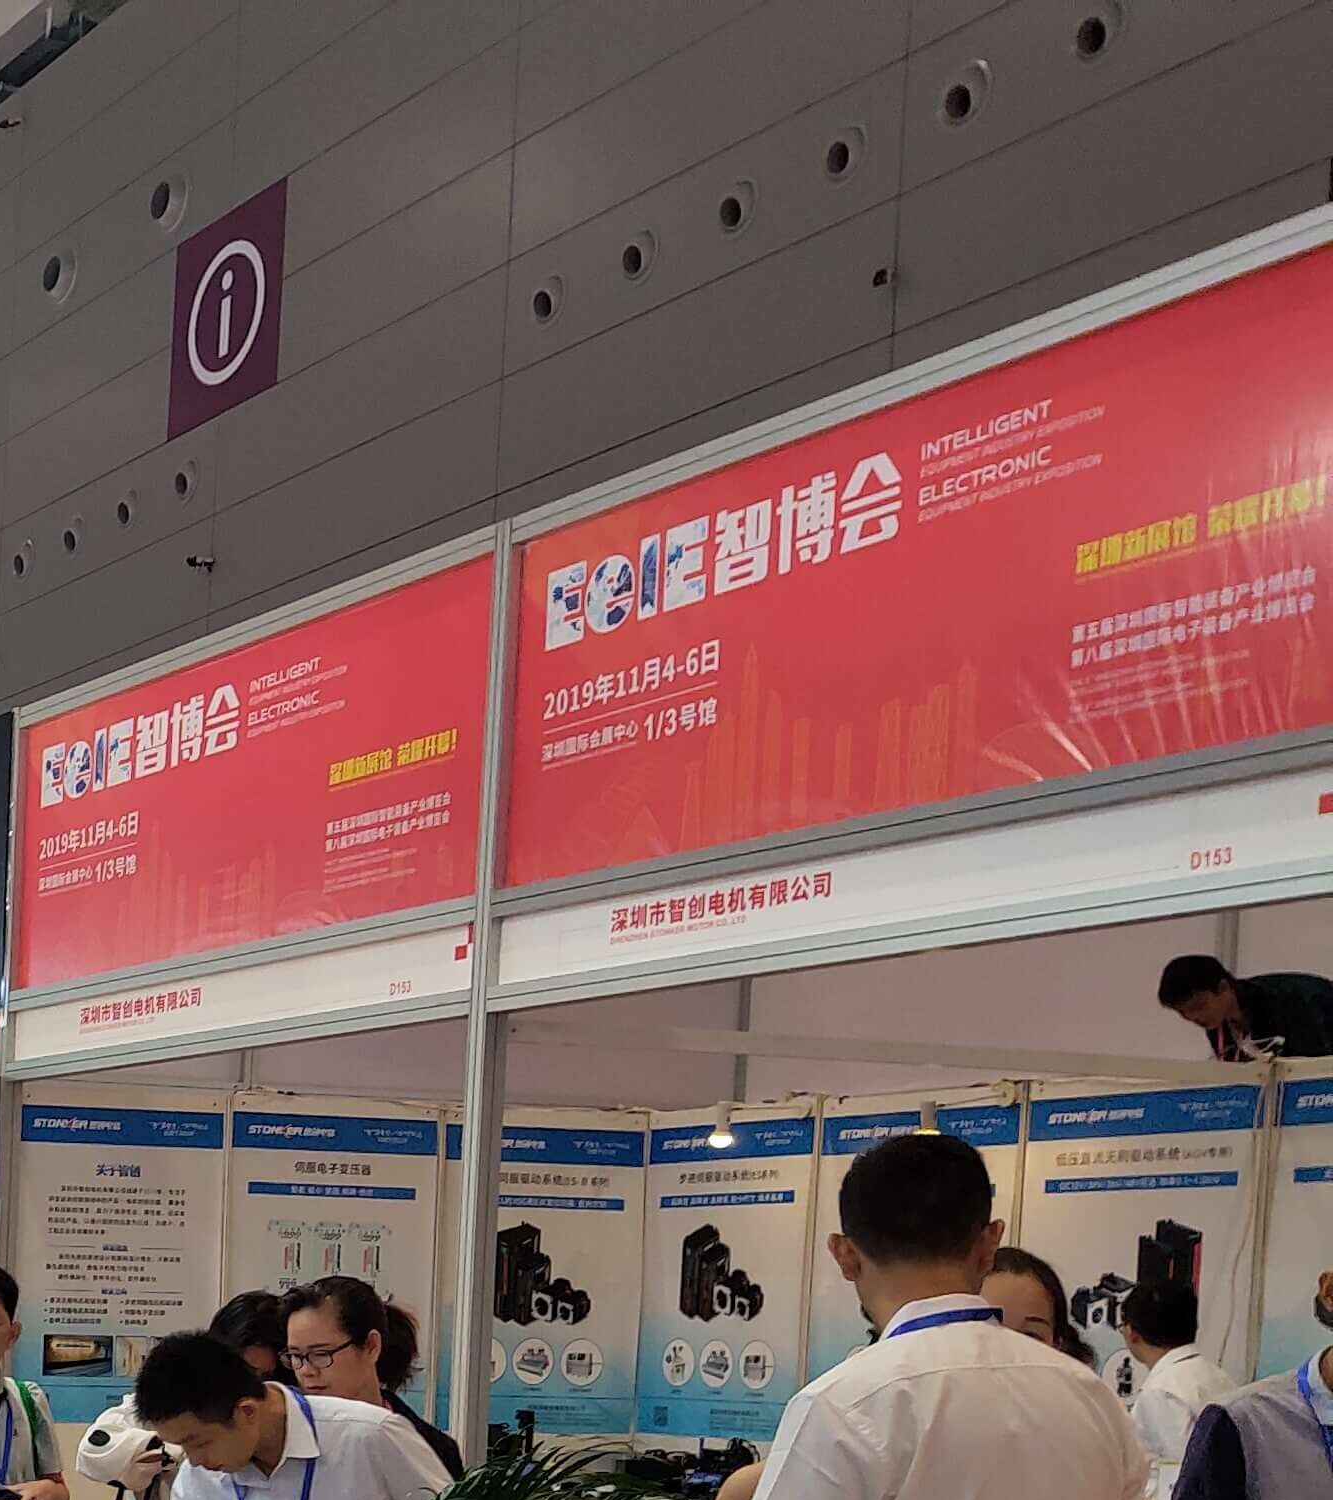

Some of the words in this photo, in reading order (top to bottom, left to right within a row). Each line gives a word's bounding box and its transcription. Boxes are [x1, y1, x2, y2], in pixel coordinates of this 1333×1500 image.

[921, 399, 1053, 461] INTELLIGENT
[918, 445, 1052, 506] ELECTRONIC
[543, 640, 720, 720] 2019年11月4-6日
[39, 811, 140, 860] 2019年11月4-6日
[1190, 847, 1233, 870] D153
[611, 872, 832, 934] 深圳市智创电机有限公司
